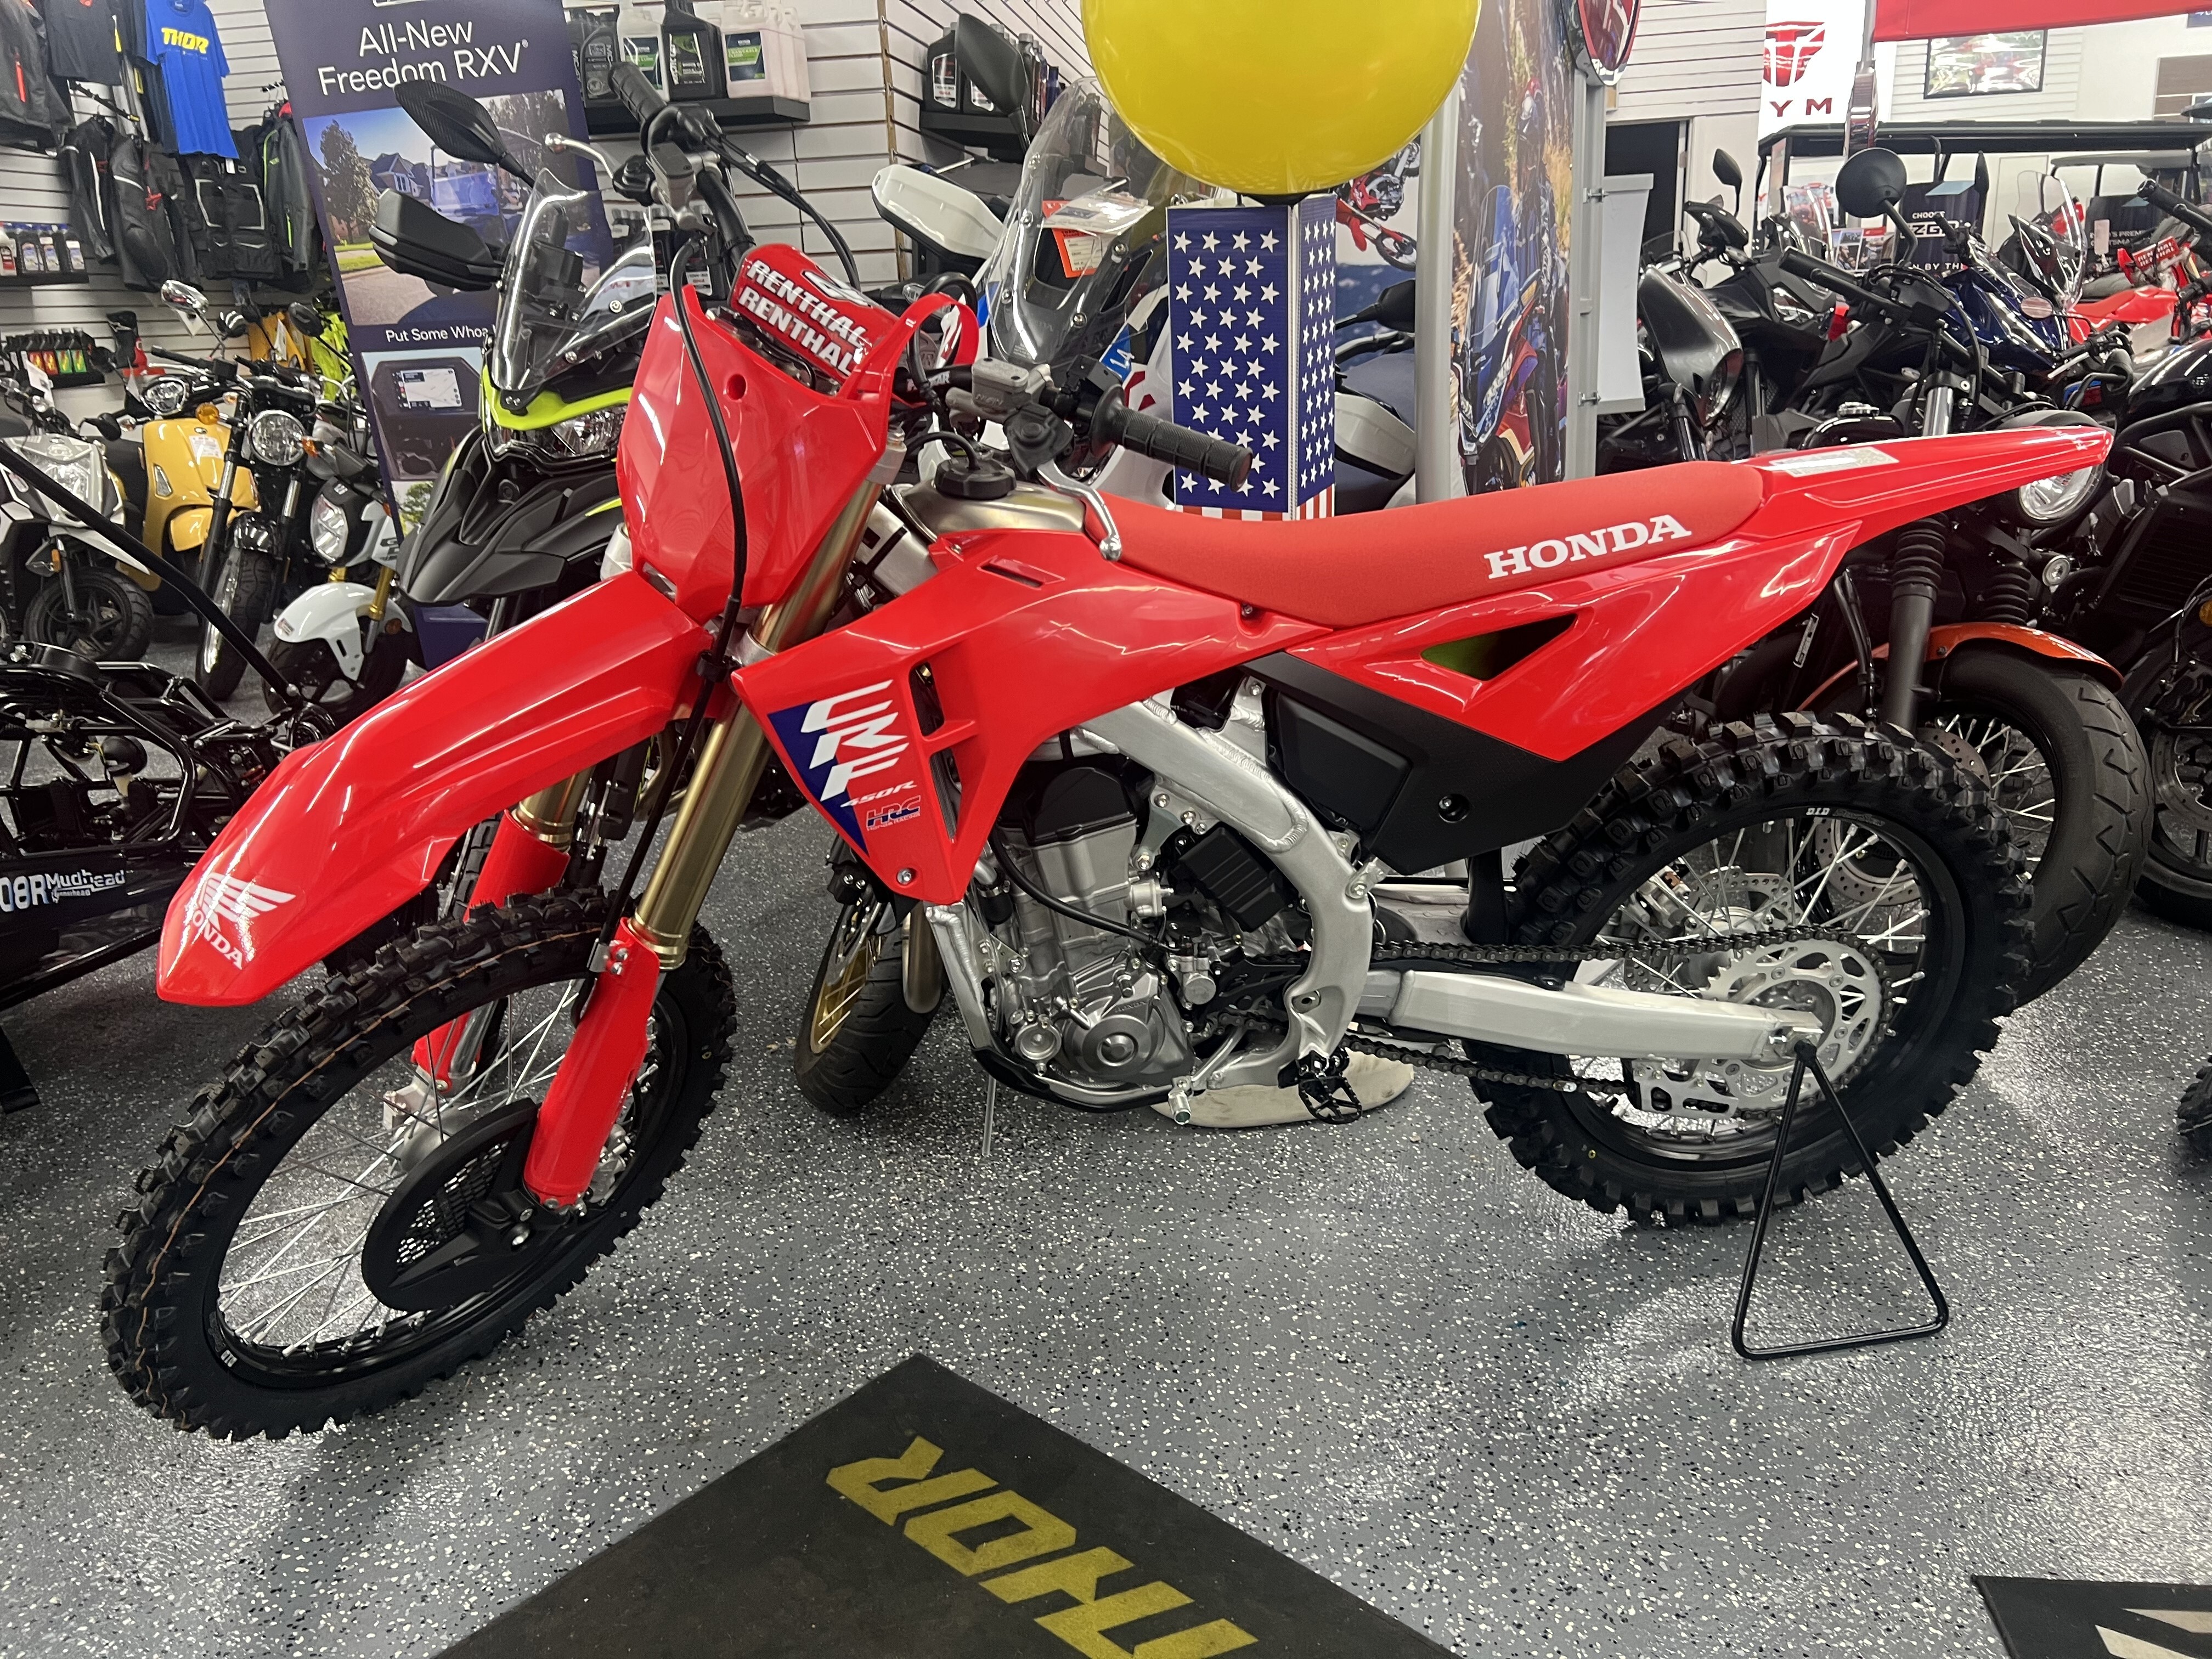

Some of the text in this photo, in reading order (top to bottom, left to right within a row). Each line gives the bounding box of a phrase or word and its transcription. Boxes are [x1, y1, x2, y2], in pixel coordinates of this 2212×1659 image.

[161, 28, 209, 54] THOR
[359, 19, 472, 57] All-New
[318, 58, 447, 95] Freedom
[1769, 97, 1833, 117] YM
[1912, 211, 1945, 219] CHOO
[747, 259, 867, 349] RENTHAL
[386, 325, 488, 342] Put Some Whoa
[738, 286, 853, 377] RENTHAL
[1485, 514, 1691, 579] HONDA
[800, 679, 910, 802] CRF
[840, 780, 918, 808] 450R
[866, 795, 921, 828] HRC
[0, 869, 125, 912] 08R Mudhead
[189, 905, 243, 970] ONDA
